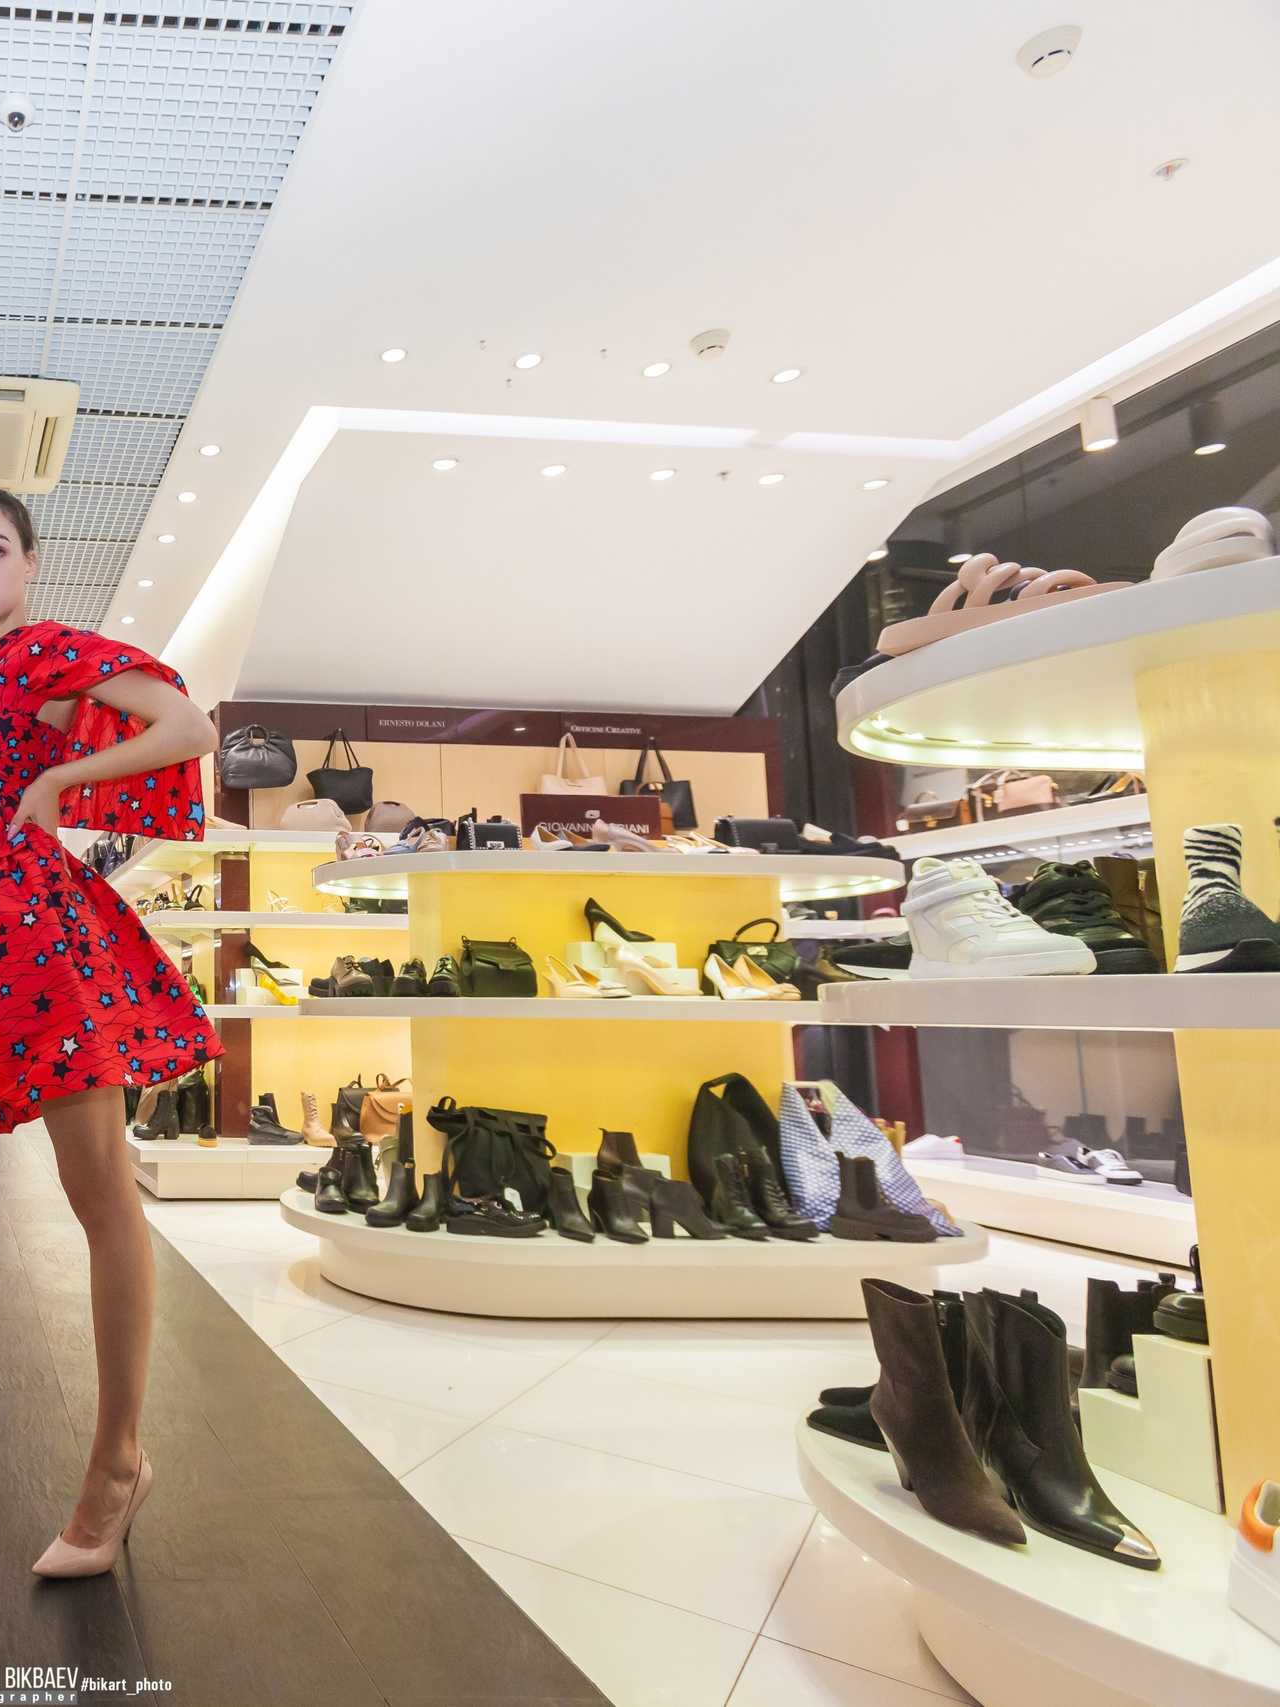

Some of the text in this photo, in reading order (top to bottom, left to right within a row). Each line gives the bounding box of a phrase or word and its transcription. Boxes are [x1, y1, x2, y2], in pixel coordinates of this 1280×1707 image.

[379, 719, 446, 728] ERNESTO DOLANI
[539, 821, 595, 832] GIOVANN
